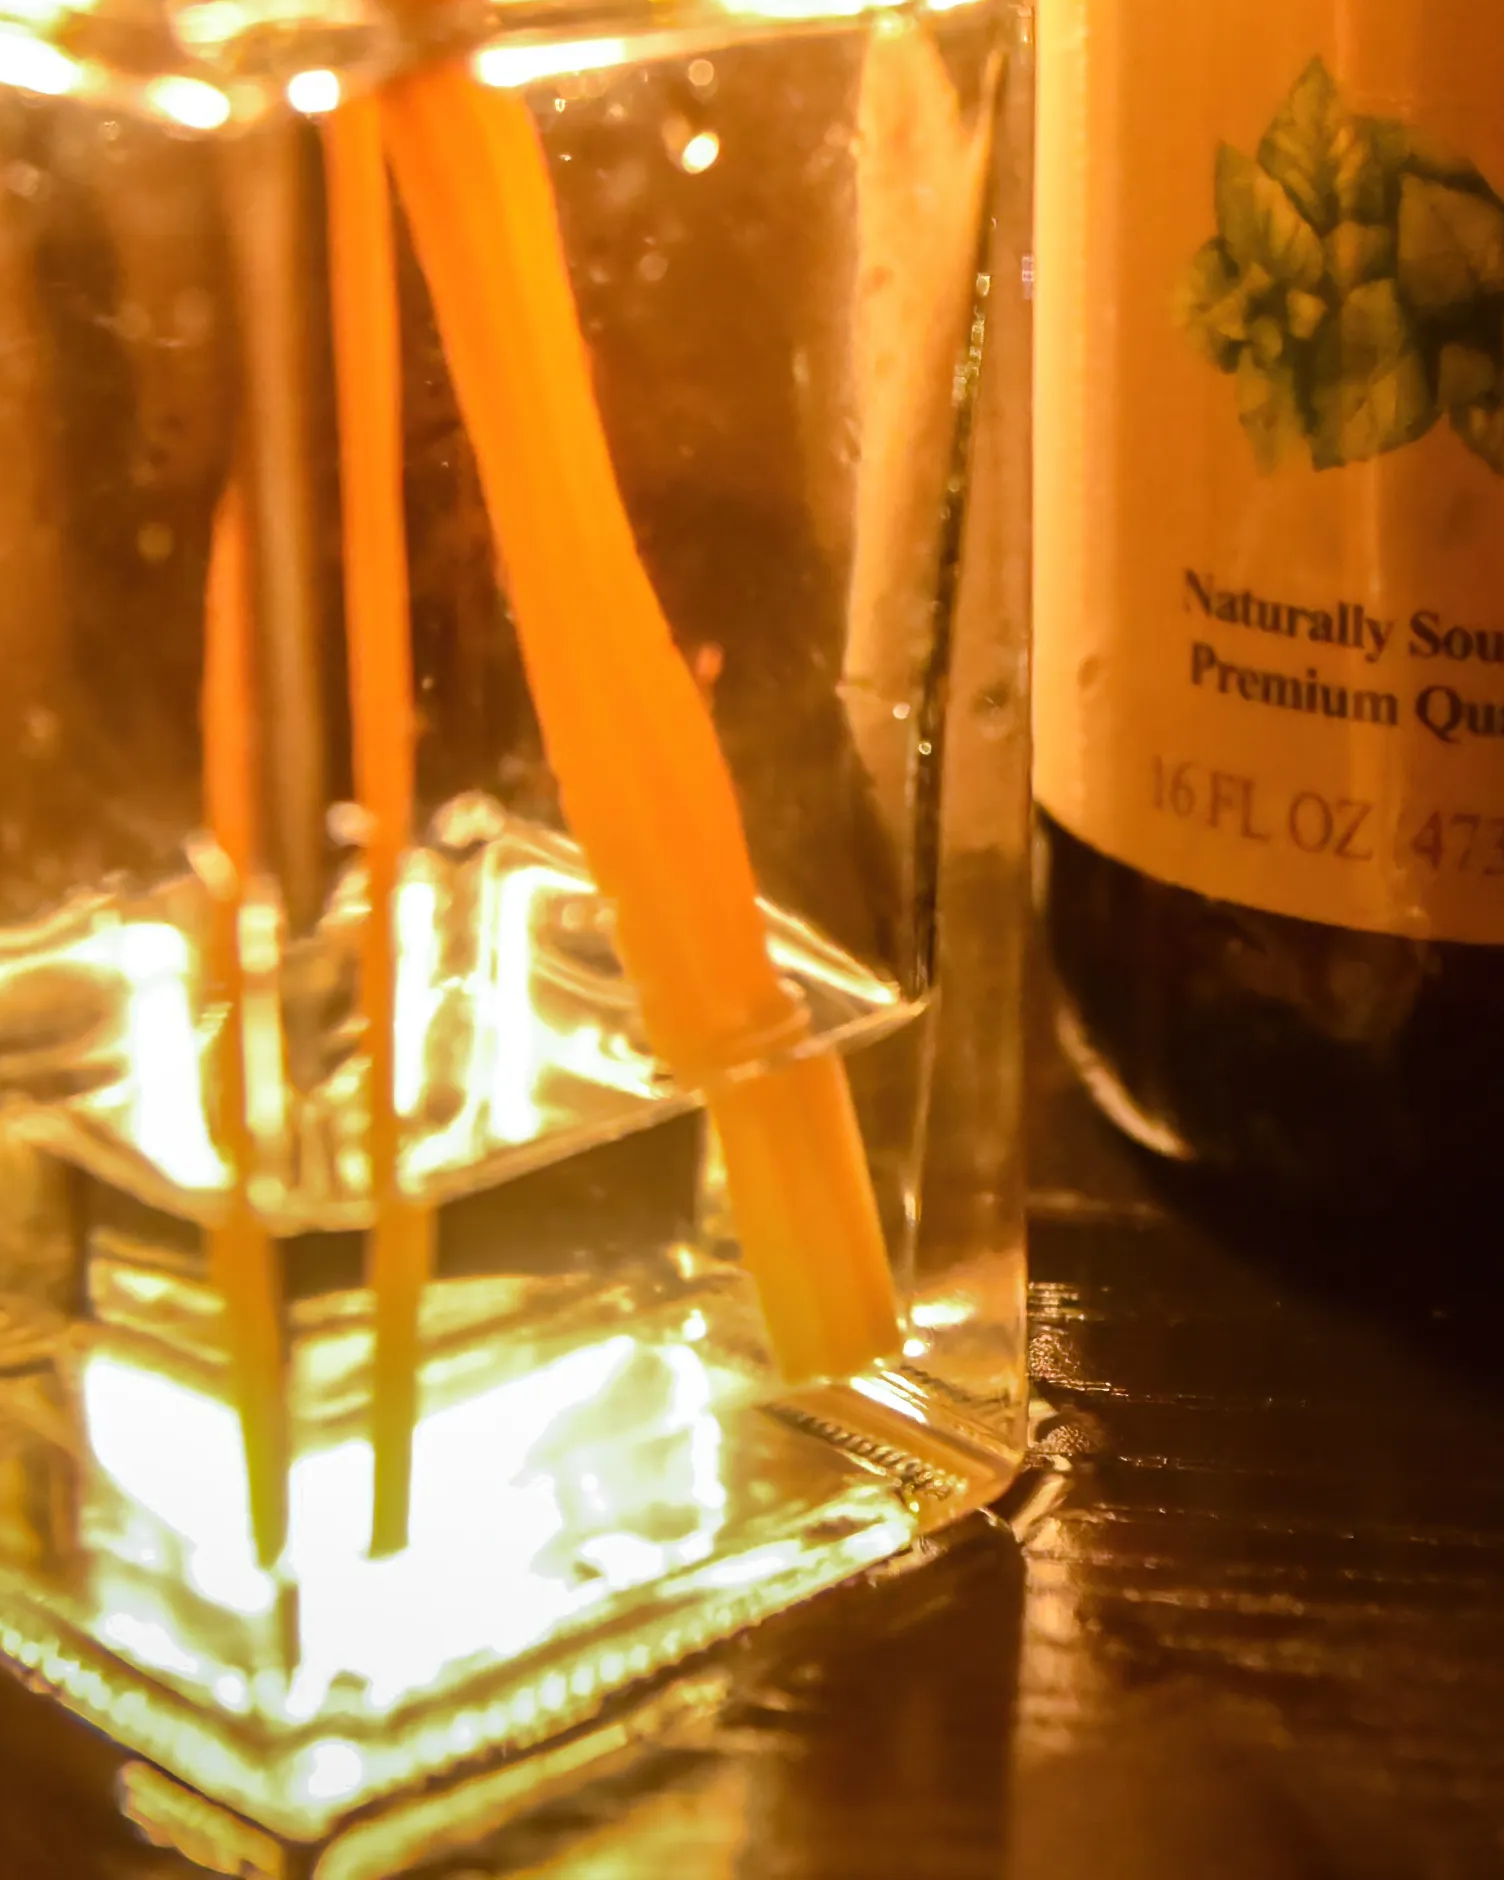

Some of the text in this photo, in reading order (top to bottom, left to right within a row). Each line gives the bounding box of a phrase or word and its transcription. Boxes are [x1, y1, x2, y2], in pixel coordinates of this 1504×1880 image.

[1183, 567, 1395, 663] Naturally
[1188, 641, 1399, 726] Premium
[1149, 753, 1198, 819] 16
[1206, 769, 1272, 843] FL
[1287, 791, 1375, 862] OZ
